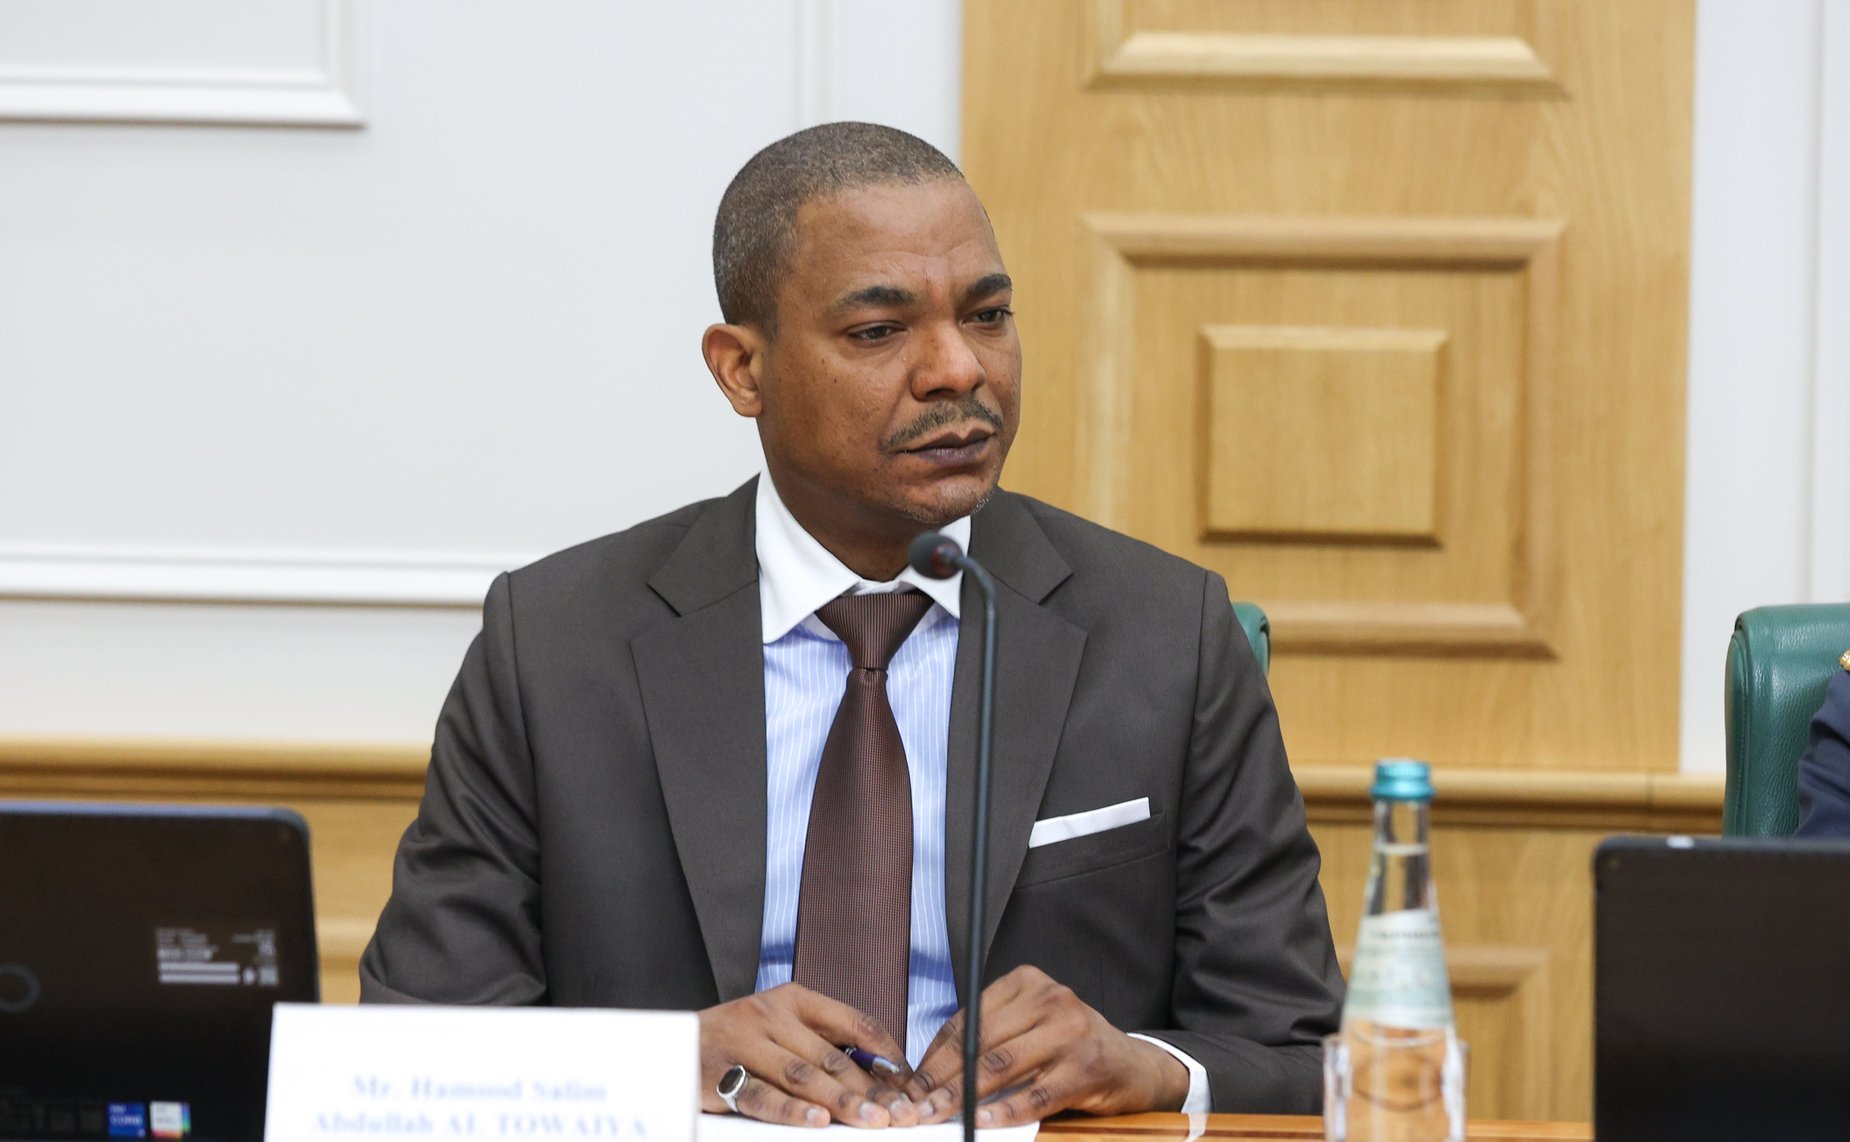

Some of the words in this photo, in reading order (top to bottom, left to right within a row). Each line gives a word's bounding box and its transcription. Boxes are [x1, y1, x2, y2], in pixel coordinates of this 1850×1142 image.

[353, 1074, 401, 1098] Mr.
[409, 1074, 523, 1101] Hamood
[531, 1077, 608, 1102] Salim
[313, 1109, 434, 1136] Abdullah
[446, 1112, 486, 1136] AL
[497, 1112, 648, 1138] TOWAIYA
